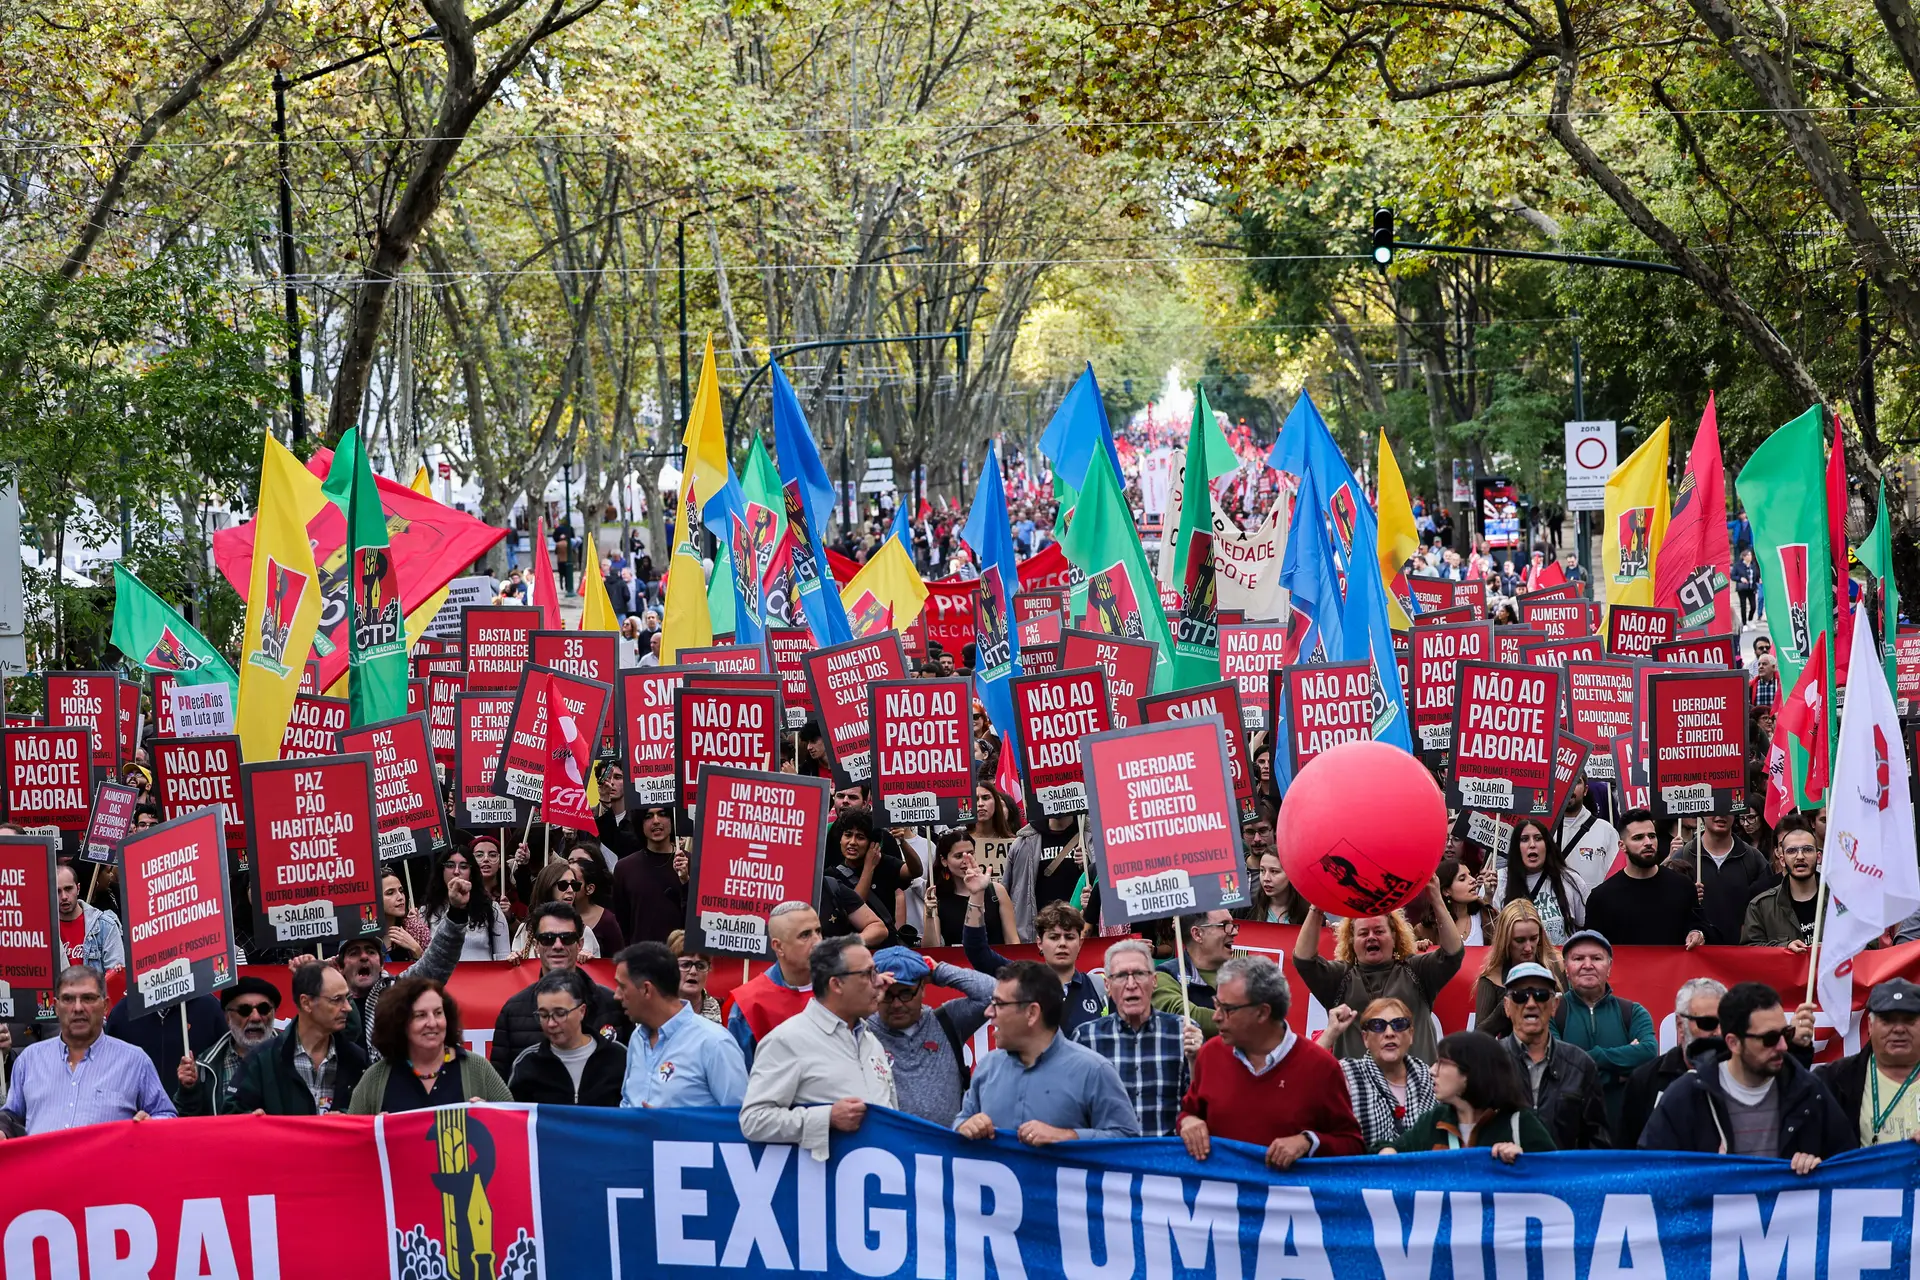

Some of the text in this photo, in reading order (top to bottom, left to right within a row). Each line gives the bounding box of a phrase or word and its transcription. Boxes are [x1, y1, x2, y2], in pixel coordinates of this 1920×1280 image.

[1024, 598, 1051, 609] DIREITO
[1531, 607, 1578, 621] AUMENTO
[1620, 613, 1666, 633] NÃO AO
[479, 628, 527, 642] BASTA DE
[1026, 623, 1038, 635] PAZ
[564, 639, 583, 658] 35
[1227, 631, 1282, 652] NÃO AO
[1423, 633, 1479, 658] NÃO AO
[1501, 639, 1518, 650] PAZ
[1903, 640, 1911, 648] UM
[827, 645, 881, 672] AUMENTO
[1097, 644, 1119, 661] PAZ
[1501, 651, 1518, 664] PÃO
[469, 660, 476, 672] A
[828, 662, 889, 690] GERAL DOS
[1573, 673, 1632, 690] CONTRATAÇÃO
[72, 679, 88, 696] 35
[434, 682, 448, 702] NÃO
[788, 681, 806, 694] NÃO!
[1301, 672, 1369, 701] NÃO AO
[1473, 672, 1545, 705] NÃO AO
[1573, 688, 1615, 703] COLETIVA,
[61, 697, 102, 714] HORAS
[886, 690, 956, 718] NÃO AO
[1026, 681, 1094, 713] NÃO AO
[1673, 696, 1726, 712] LIBERDADE
[479, 702, 494, 713] UM
[692, 699, 763, 729] NÃO AO
[1303, 699, 1372, 728] PACOTE
[181, 711, 225, 727] em Luta por
[323, 708, 345, 728] AO
[471, 716, 483, 728] DE
[1030, 709, 1100, 741] PACOTE
[1469, 704, 1545, 734] PACOTE
[1578, 710, 1633, 725] CADUCIDADE,
[1677, 713, 1722, 727] SINDICAL
[372, 730, 394, 748] PAZ
[886, 720, 959, 747] PACOTE
[1597, 723, 1617, 738] NÃO!
[1677, 728, 1723, 743] É DIREITO
[15, 736, 77, 761] NÃO AO
[691, 732, 765, 758] PACOTE
[1459, 732, 1548, 764] LABORAL
[1659, 743, 1741, 760] CONSTITUCIONAL
[165, 747, 228, 775] NÃO AO
[375, 746, 396, 765] PÃO
[509, 757, 527, 767] OUTRO
[880, 748, 968, 776] LABORAL
[15, 763, 80, 786] PACOTE
[633, 764, 673, 774] OUTRO RUMO
[1117, 752, 1196, 781] LIBERDADE
[1459, 763, 1482, 774] OUTRO
[1483, 764, 1504, 775] RUMO
[295, 771, 324, 792] PAZ
[883, 781, 904, 791] OUTRO
[906, 780, 925, 790] RUMO
[1033, 772, 1074, 785] OUTRO RUMO
[1661, 770, 1739, 783] OUTRO RUMO POSSÍVEL!
[167, 776, 233, 801] PACOTE
[375, 778, 410, 799] SAÚDE
[731, 782, 795, 806] UM POSTO
[1048, 787, 1079, 800] SALÁRIO
[1127, 773, 1193, 800] SINDICAL
[1471, 781, 1505, 793] SALÁRIO
[1674, 788, 1704, 799] SALÁRIO
[10, 788, 87, 811] LABORAL
[104, 790, 132, 805] AUMENTO
[296, 792, 325, 814] PÃO
[478, 800, 507, 809] SALÁRIO
[897, 796, 930, 808] SALÁRIO
[1052, 799, 1085, 812] DIREITOS
[1474, 794, 1509, 807] DIREITOS
[1678, 800, 1710, 811] DIREITOS
[109, 803, 121, 814] DAS
[481, 811, 512, 821] DIREITOS
[717, 801, 805, 827] DE TRABALHO
[901, 809, 935, 820] DIREITOS
[1129, 794, 1197, 821] É DIREITO
[96, 813, 127, 828] REFORMAS
[271, 811, 354, 840] HABITAÇÃO
[1106, 811, 1226, 846] CONSTITUCIONAL
[99, 827, 124, 840] PENSÕES
[716, 820, 803, 846] PERMANENTE
[290, 837, 338, 860] SAÚDE
[382, 842, 412, 857] DIREITOS
[142, 843, 199, 879] LIBERDADE
[729, 857, 784, 882] VÍNCULO
[1113, 848, 1228, 876] OUTRO RUMO POSSÍVEL!
[277, 857, 355, 885] EDUCAÇÃO
[148, 865, 196, 896] SINDICAL
[1134, 876, 1179, 896] SALÁRIO
[266, 881, 369, 902] OUTRO RUMO POSSÍVEL!
[724, 878, 785, 902] EFECTIVO
[1222, 892, 1241, 901] CGTP
[148, 884, 198, 916] É DIREITO
[701, 895, 753, 912] OUTRO RUMO
[1142, 892, 1189, 912] DIREITOS
[132, 898, 220, 943] CONSTITUCIONAL
[285, 906, 324, 922] SALÁRIO
[291, 921, 333, 937] DIREITOS
[362, 923, 378, 931] CGTP
[716, 917, 756, 934] SALÁRIO
[136, 932, 221, 970] OUTRO RUMO POSSÍVEL!
[719, 934, 761, 951] DIREITOS
[5, 965, 47, 977] POSSÍVEL!
[151, 965, 183, 987] SALÁRIO
[155, 979, 190, 1001] DIREITOS
[653, 1140, 1920, 1280] EXIGIR UMA VIDA ME
